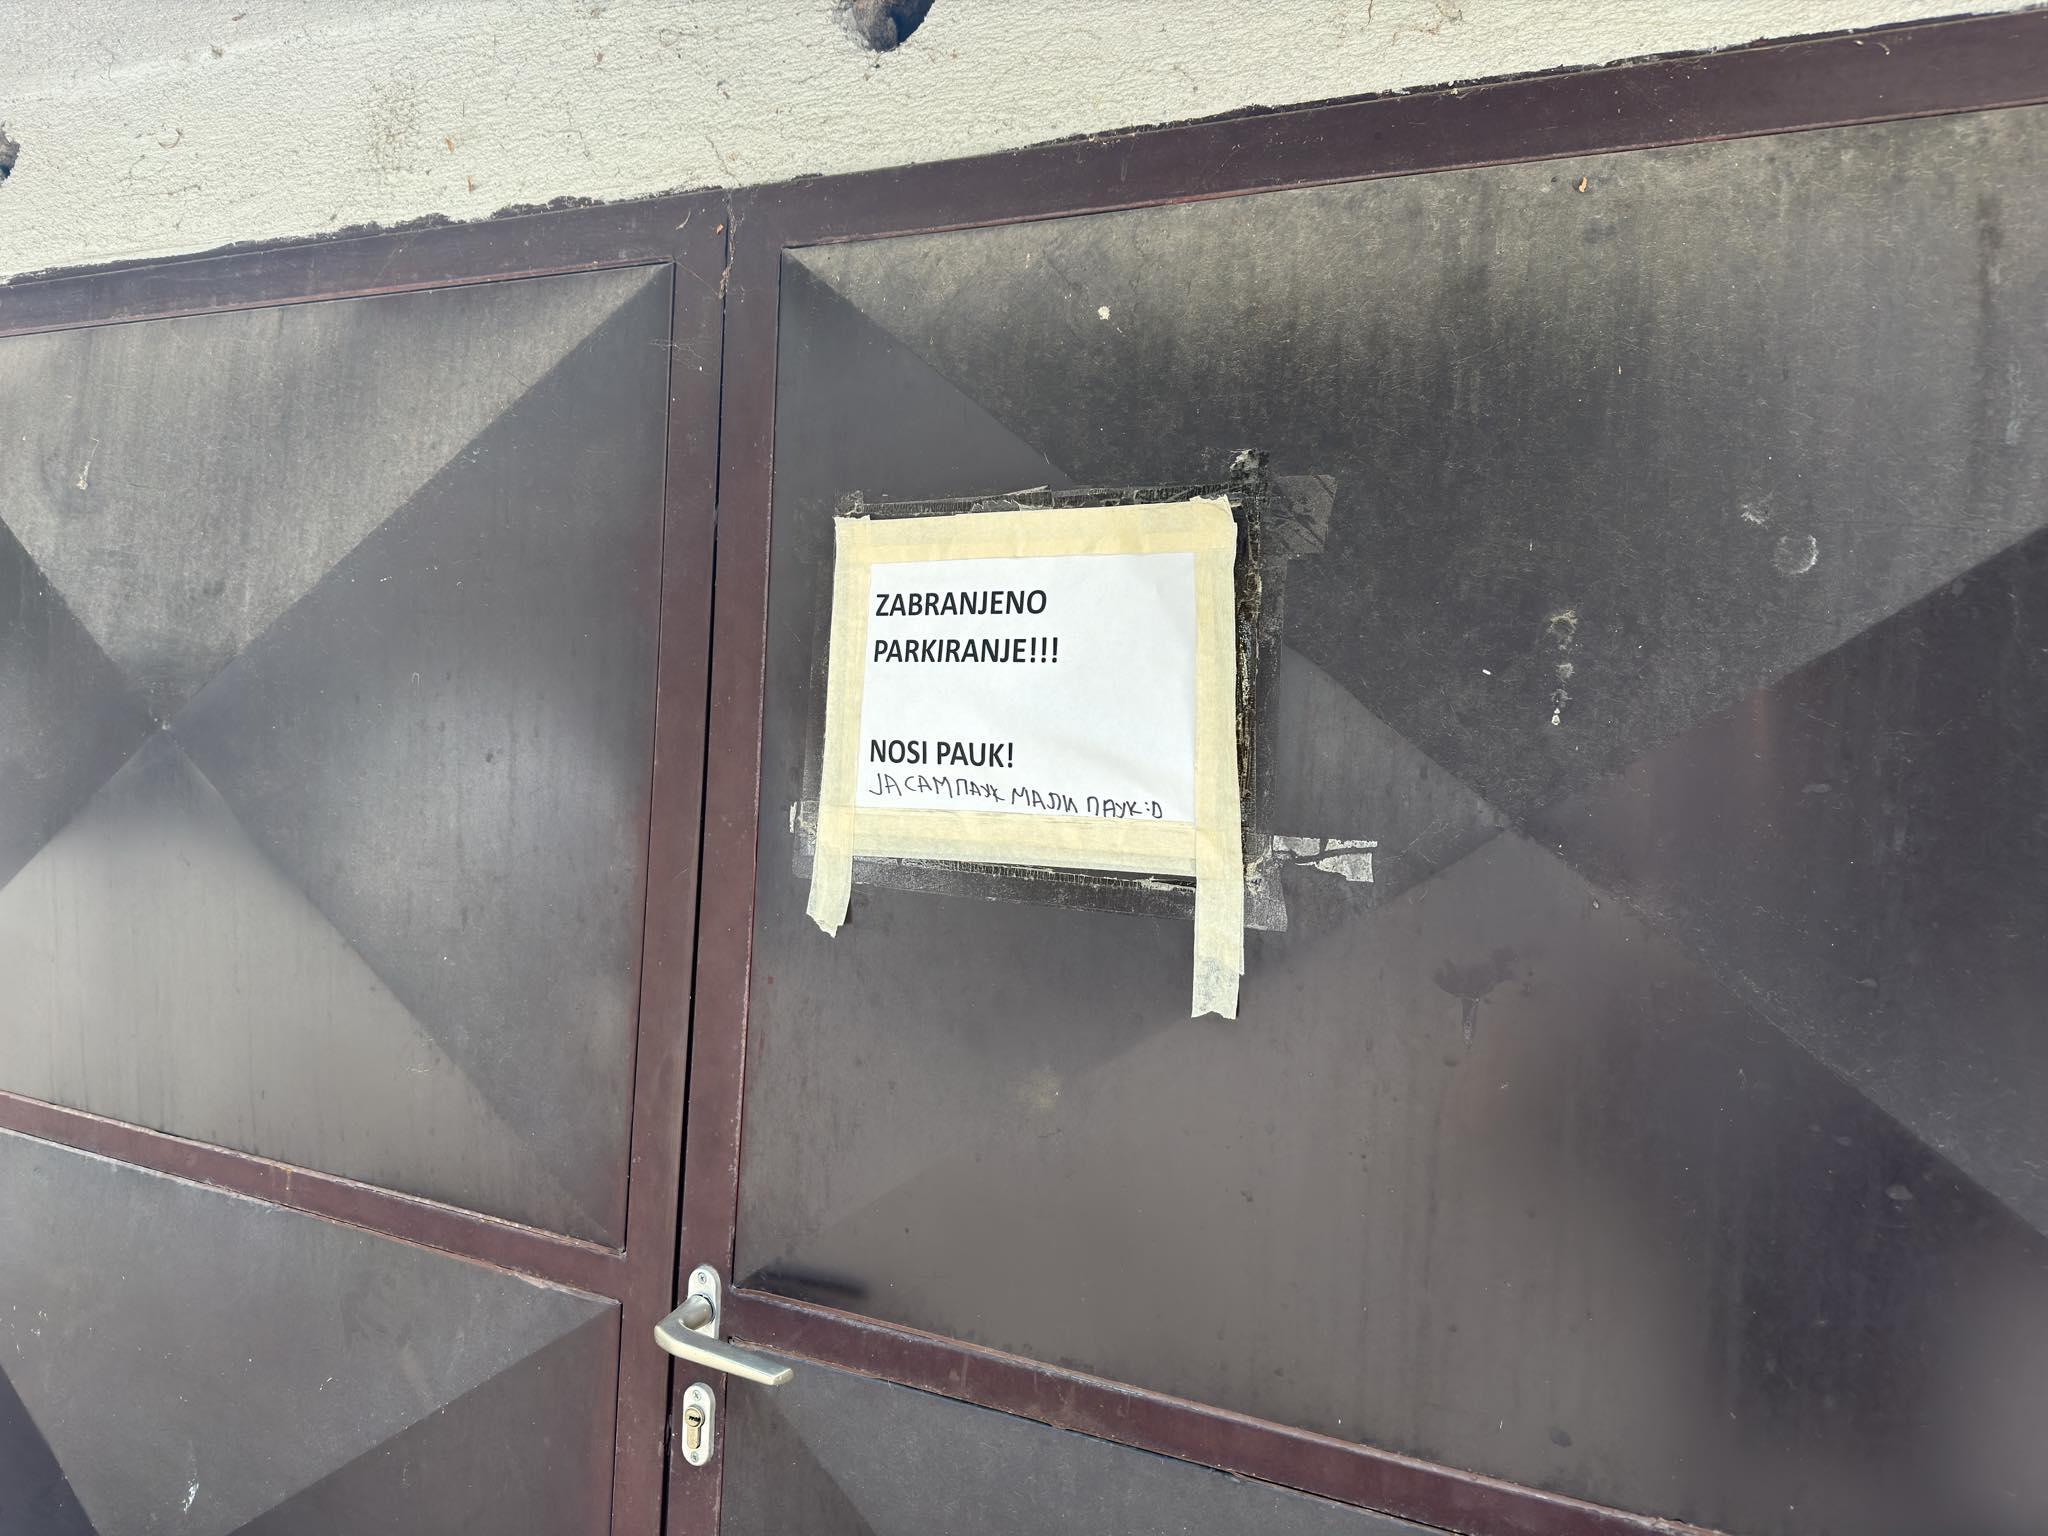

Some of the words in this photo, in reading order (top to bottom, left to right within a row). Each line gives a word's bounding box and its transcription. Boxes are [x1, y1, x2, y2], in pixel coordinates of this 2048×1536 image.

[875, 589, 1048, 617] ZABRANJENO
[873, 637, 1059, 664] PARKIRANJE!!!
[870, 739, 928, 765] NOSI
[936, 741, 1014, 769] PAUK!
